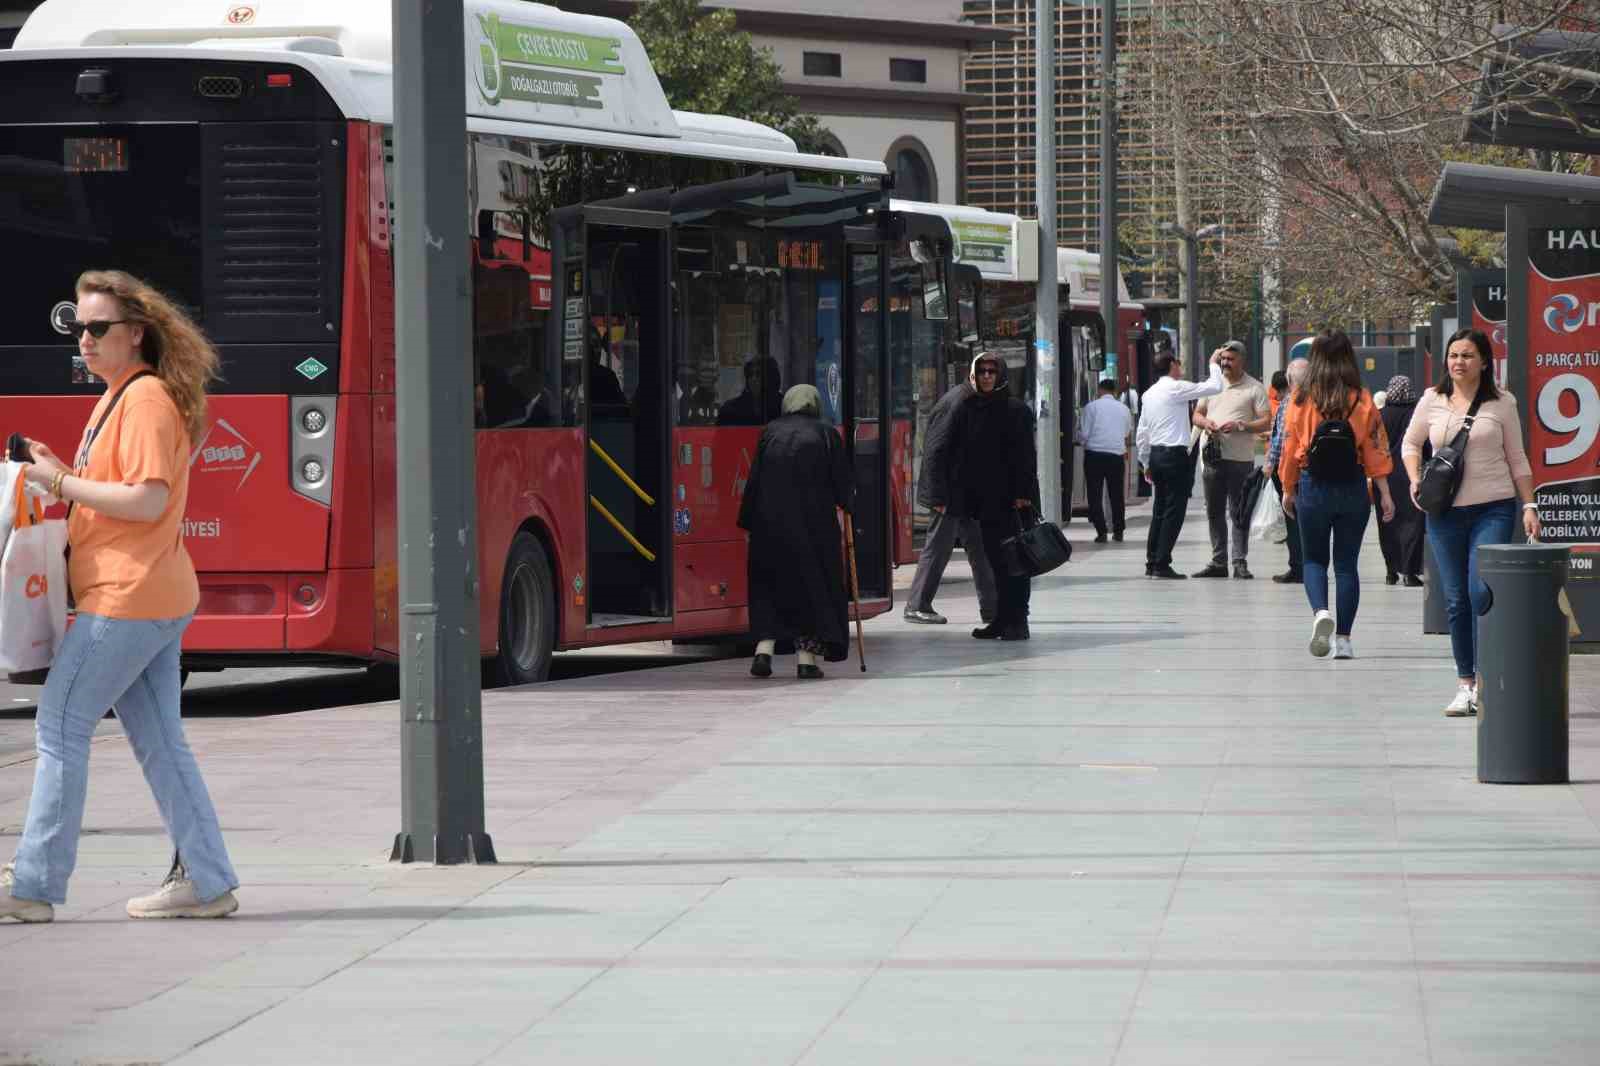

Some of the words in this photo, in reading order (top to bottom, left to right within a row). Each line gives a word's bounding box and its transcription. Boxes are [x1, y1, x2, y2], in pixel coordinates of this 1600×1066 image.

[551, 37, 589, 62] DOSTU
[552, 80, 579, 97] OTOBÜS
[1536, 353, 1543, 367] 9
[1545, 352, 1582, 370] PARÇA
[1537, 492, 1570, 505] İZMİR
[1538, 511, 1587, 521] KELEBEK
[181, 517, 220, 537] İYESİ
[1540, 525, 1588, 537] MOBİLYA
[1569, 558, 1593, 569] YON
